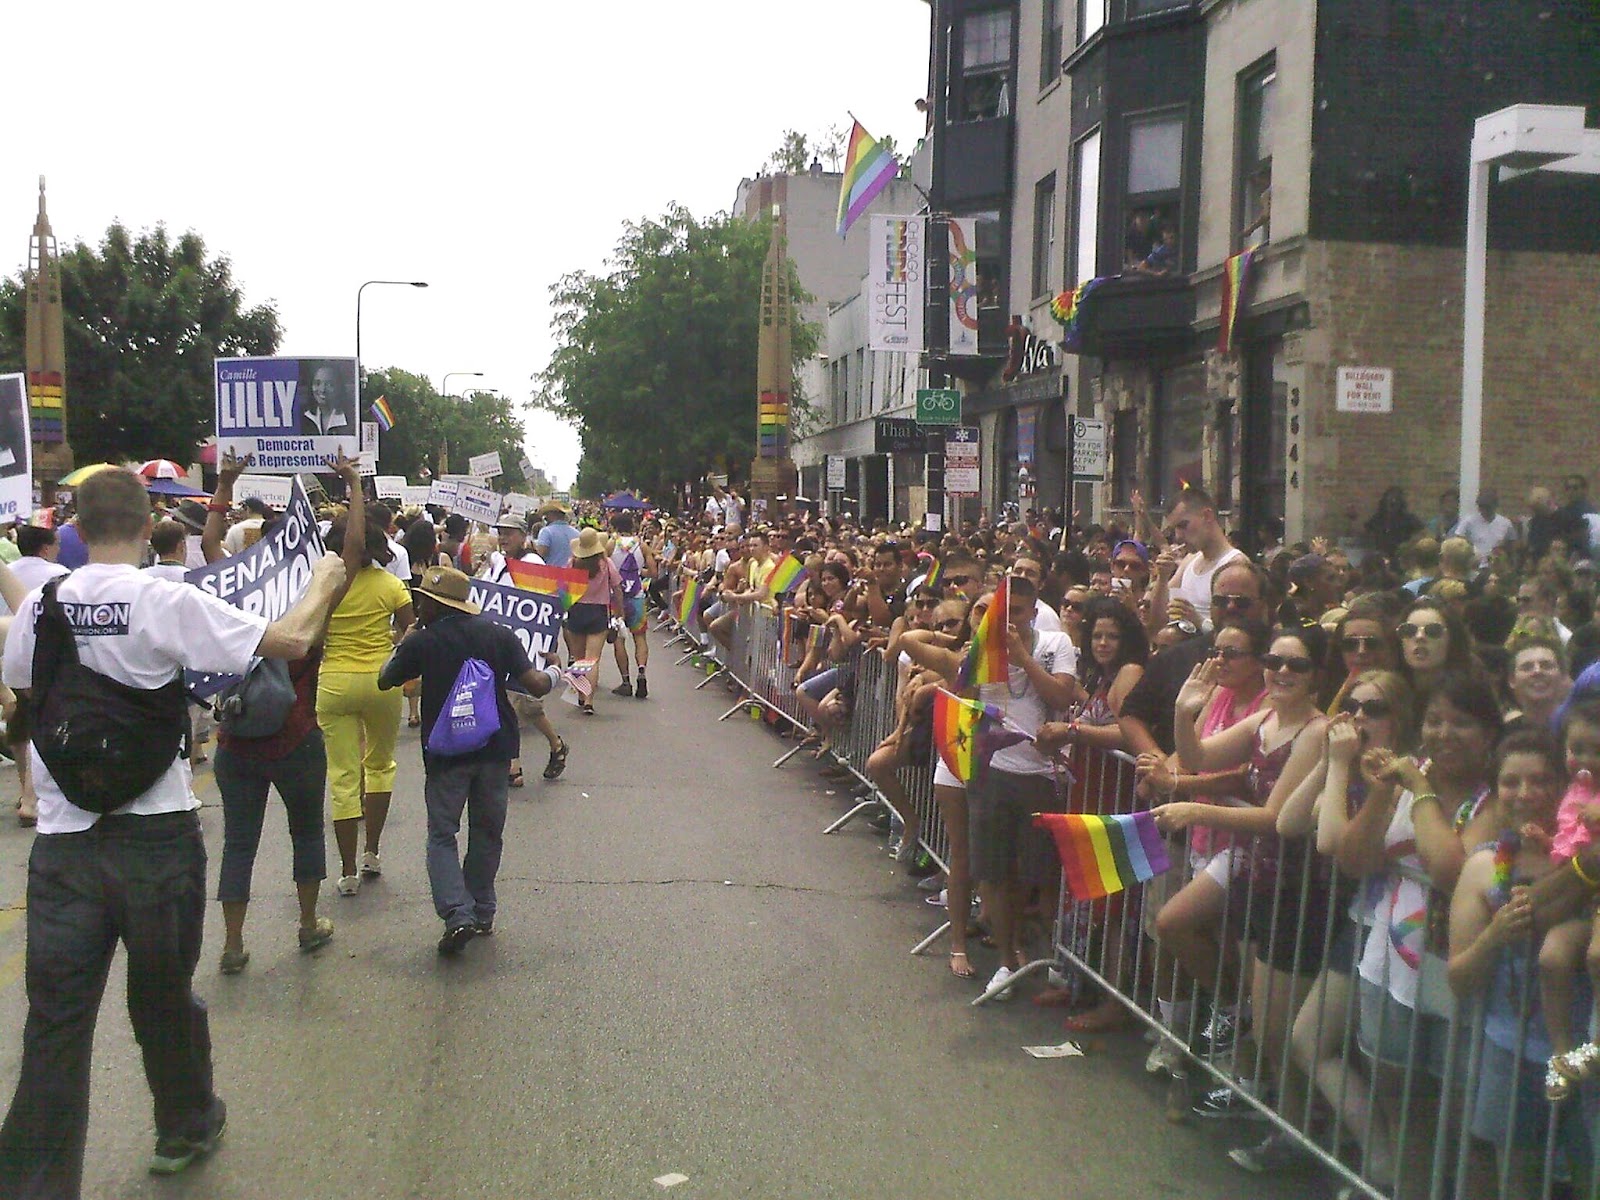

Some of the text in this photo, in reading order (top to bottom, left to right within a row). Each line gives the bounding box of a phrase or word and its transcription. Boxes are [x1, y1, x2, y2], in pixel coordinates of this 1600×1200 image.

[907, 221, 919, 282] CHICAGO
[875, 282, 886, 325] 2012
[219, 368, 257, 381] Camille
[220, 380, 297, 429] LILLY
[257, 438, 315, 452] Democrat
[879, 422, 911, 438] Thai
[455, 497, 498, 518] CULLERTON
[201, 499, 309, 598] SENATOR
[243, 530, 324, 622] RMON
[33, 603, 129, 626] HRMON
[465, 586, 550, 626] NATOR
